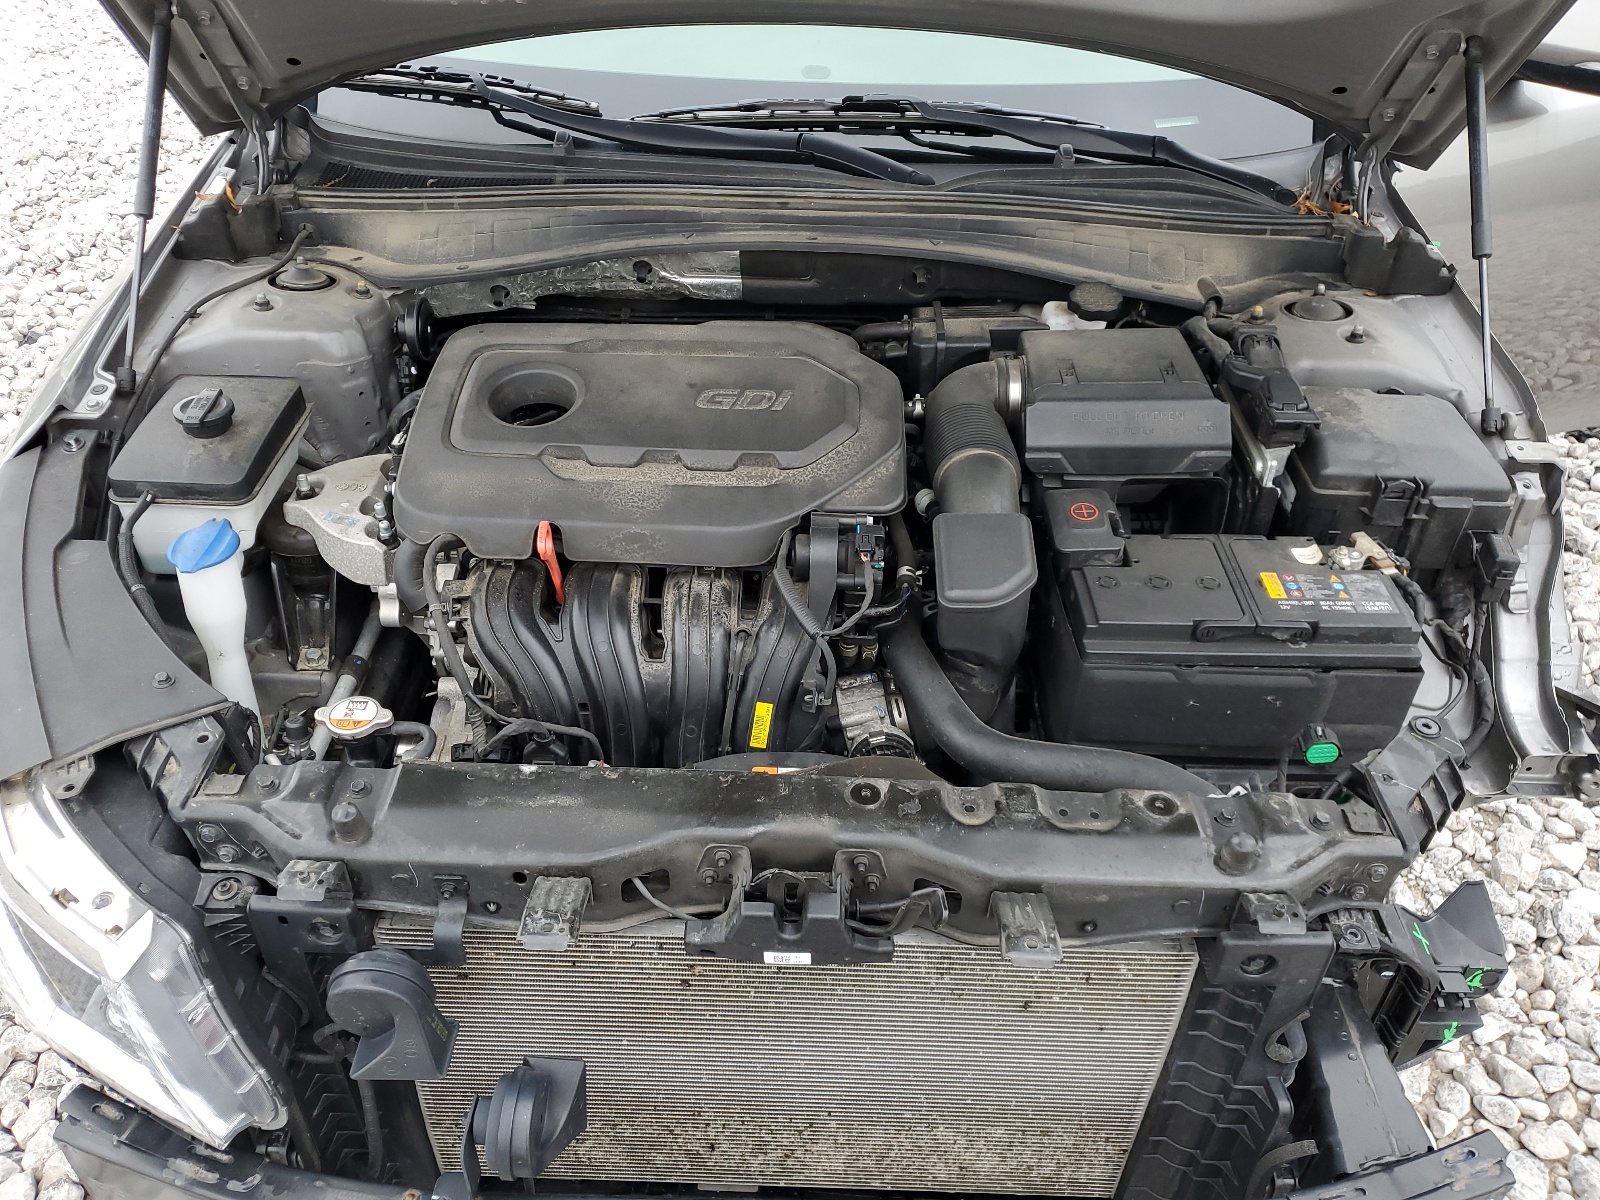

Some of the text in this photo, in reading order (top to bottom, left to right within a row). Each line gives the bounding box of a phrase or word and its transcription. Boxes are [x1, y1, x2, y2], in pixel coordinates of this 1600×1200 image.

[694, 388, 794, 411] GDi
[1072, 411, 1185, 422] PULL OUT TO OPEN
